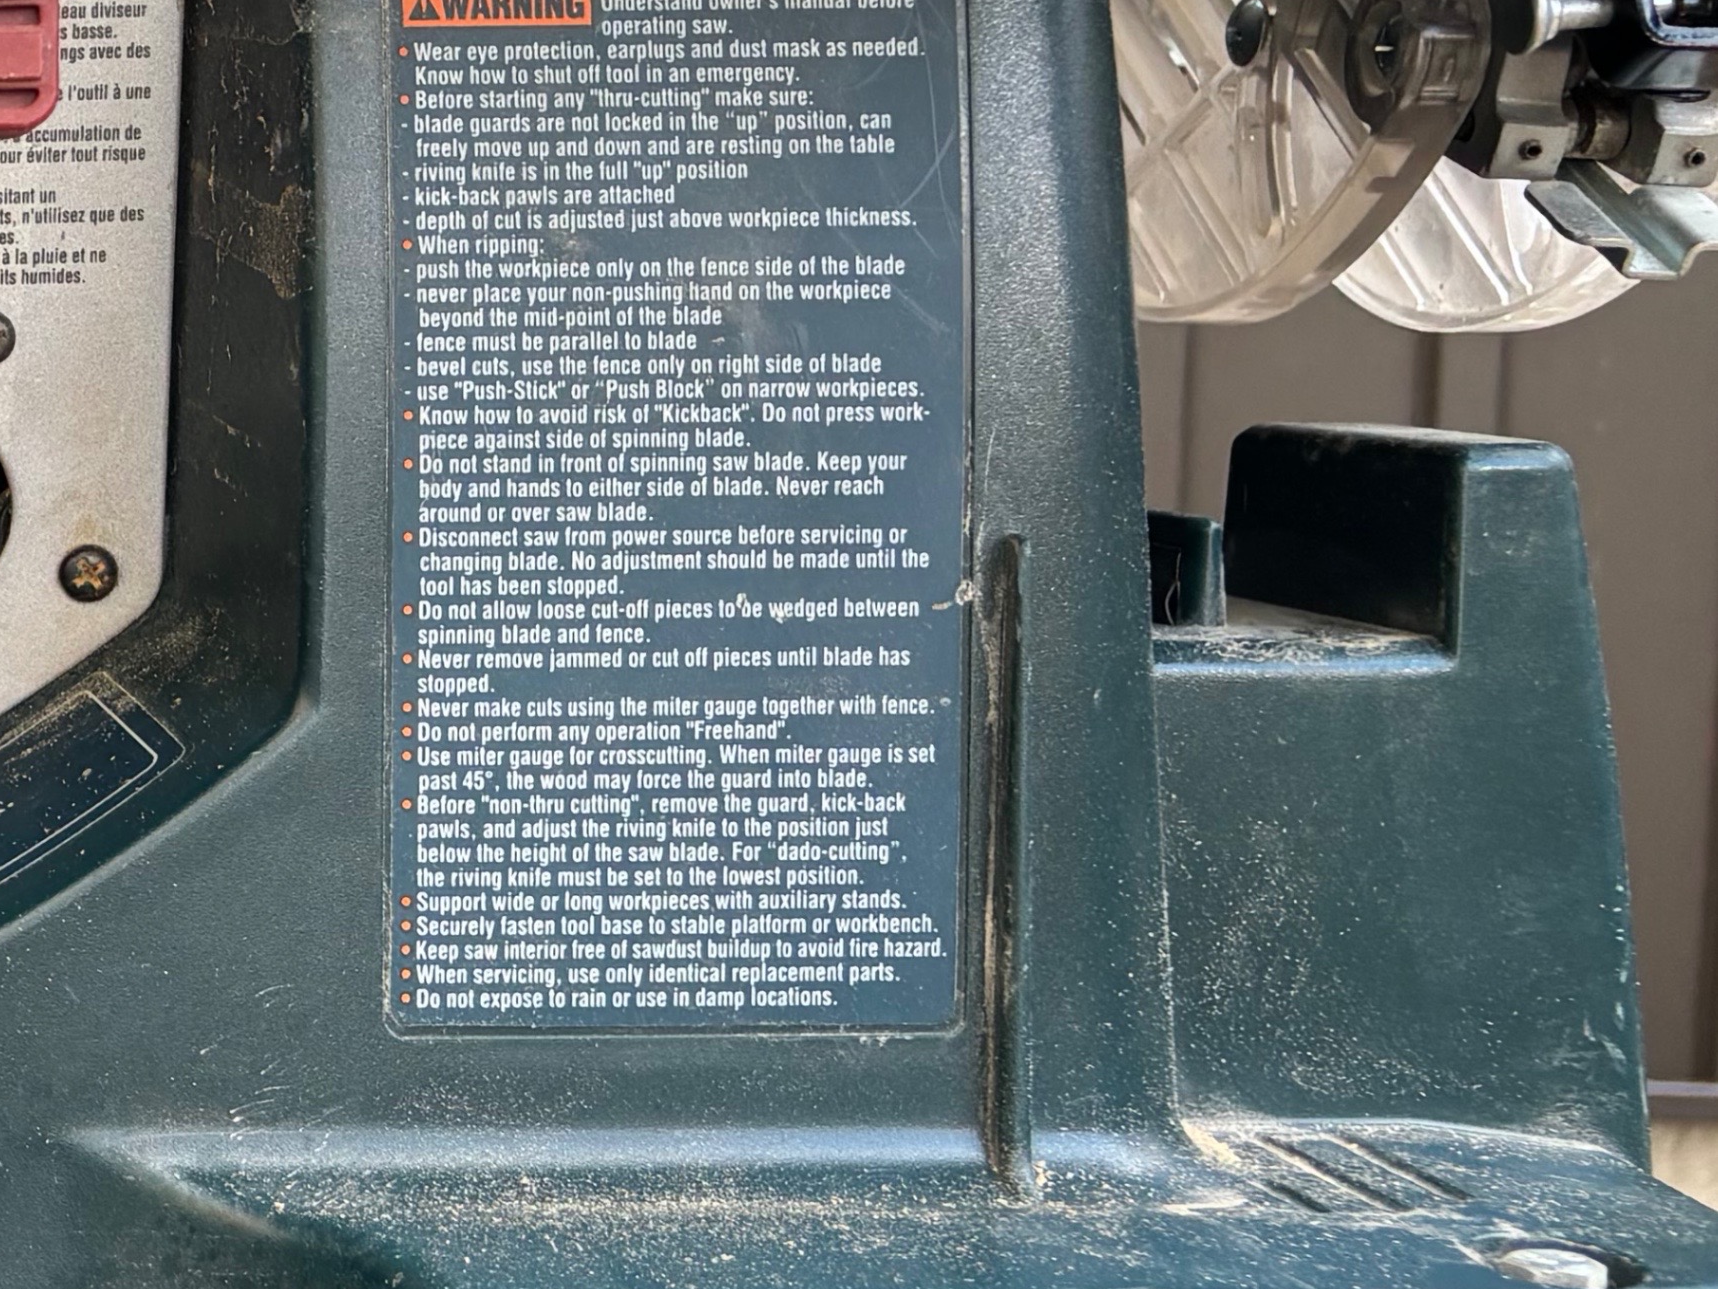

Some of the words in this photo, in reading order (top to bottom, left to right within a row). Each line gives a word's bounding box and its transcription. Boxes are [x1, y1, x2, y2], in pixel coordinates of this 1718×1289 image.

[602, 17, 687, 39] operating
[692, 20, 734, 35] saw.
[419, 526, 518, 547] Disconnect
[524, 530, 560, 546] saw
[565, 526, 606, 546] from
[612, 528, 666, 550] power
[672, 528, 732, 545] source
[738, 525, 795, 545] before
[800, 524, 883, 548] servicing
[889, 527, 908, 544] or
[416, 988, 441, 1009] Do
[447, 989, 475, 1008] not
[480, 992, 544, 1012] expose
[548, 988, 566, 1008] to
[571, 987, 606, 1007] rain
[612, 992, 631, 1007] or
[636, 991, 666, 1007] use
[673, 986, 690, 1007] in
[695, 986, 744, 1011] damp
[750, 985, 838, 1007] locations.
